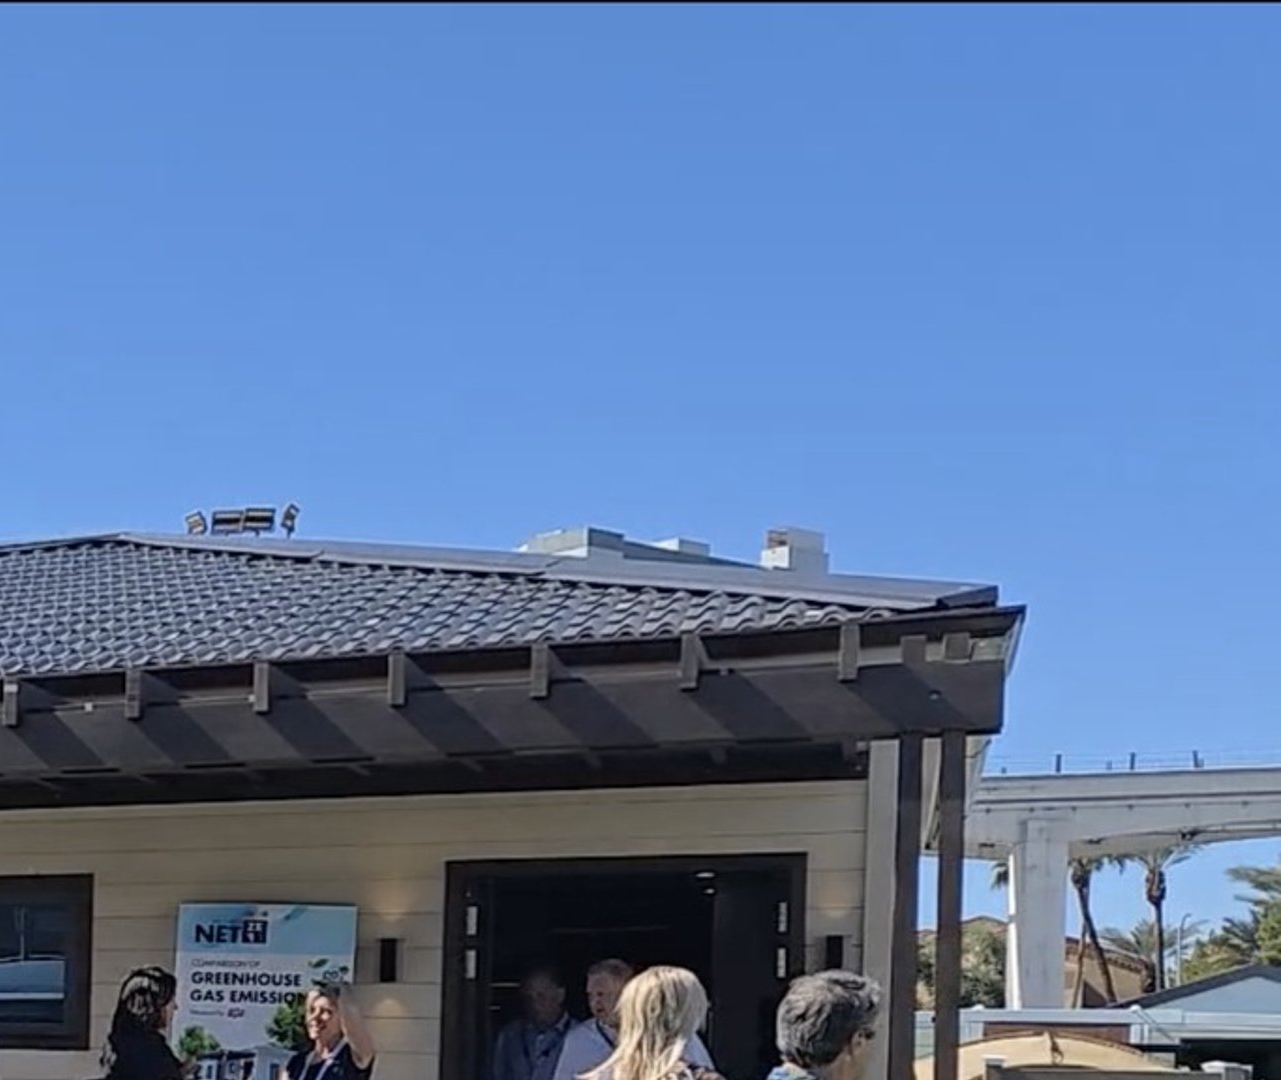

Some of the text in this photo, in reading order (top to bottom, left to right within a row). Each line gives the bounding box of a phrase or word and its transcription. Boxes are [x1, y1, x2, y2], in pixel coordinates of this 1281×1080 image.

[195, 924, 240, 943] NET
[191, 971, 303, 987] GREENHOUSE
[190, 989, 225, 1003] GAS
